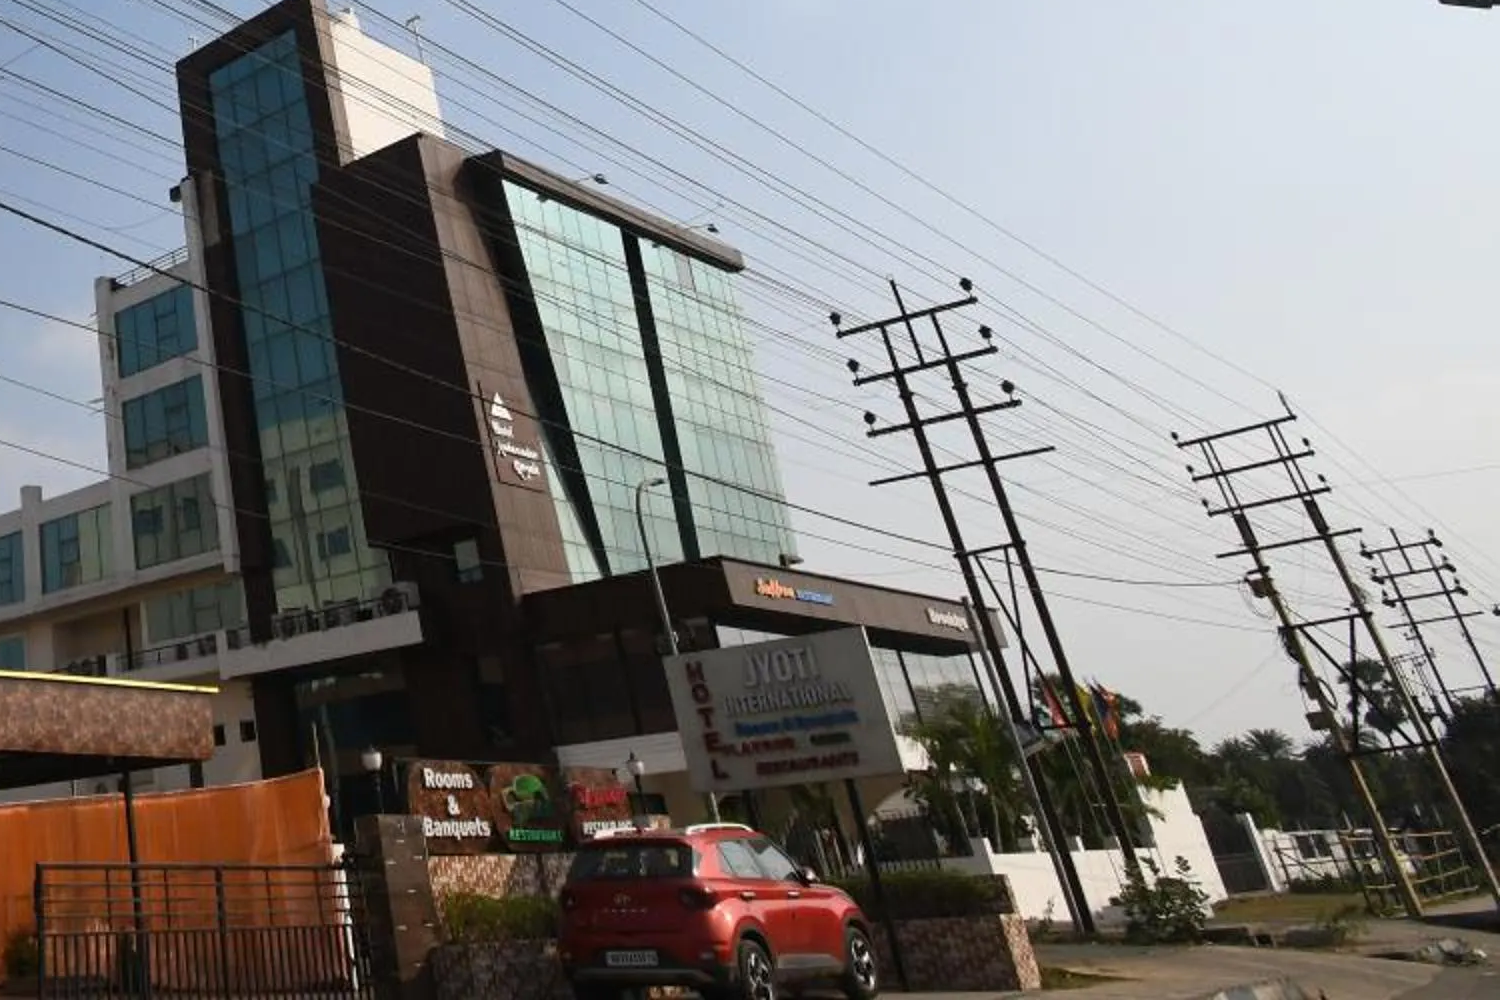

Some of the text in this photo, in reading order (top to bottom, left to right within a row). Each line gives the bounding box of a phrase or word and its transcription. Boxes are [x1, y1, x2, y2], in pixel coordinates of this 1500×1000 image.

[743, 646, 819, 690] JYOTI
[423, 768, 474, 789] Rooms
[447, 794, 460, 815] &
[422, 816, 491, 841] Banquets
